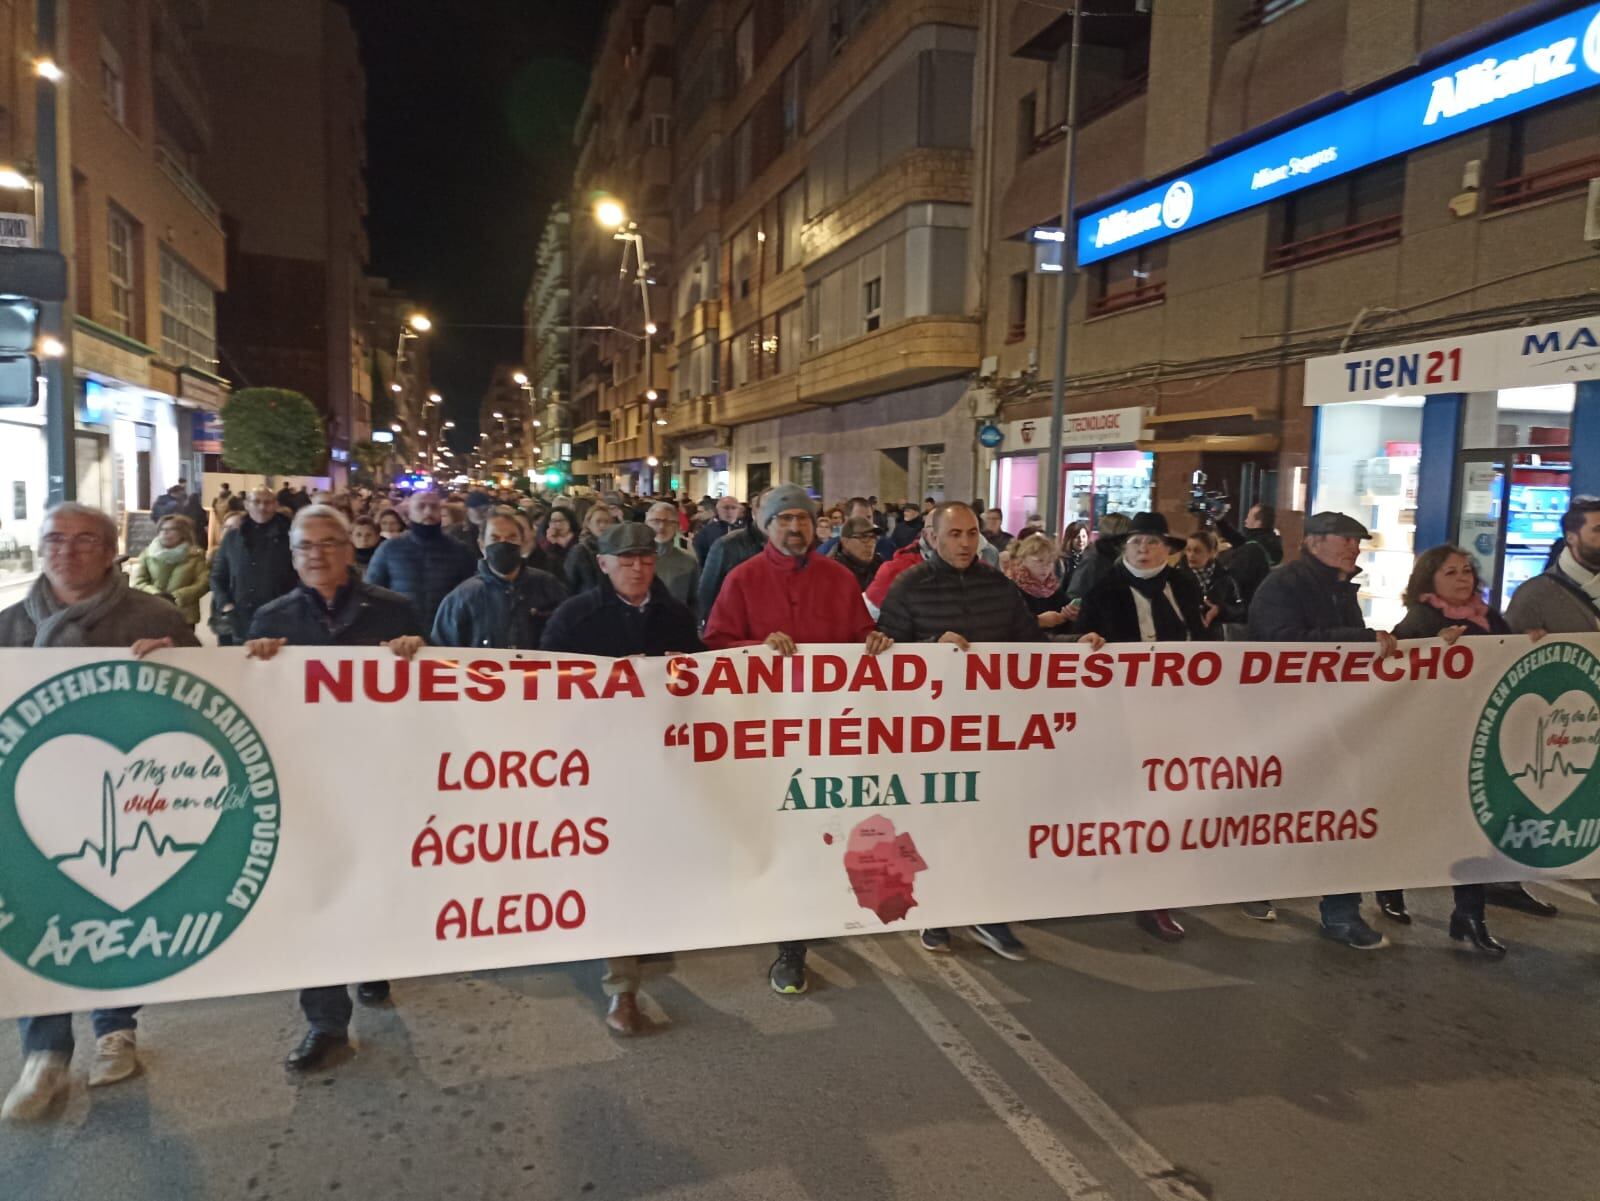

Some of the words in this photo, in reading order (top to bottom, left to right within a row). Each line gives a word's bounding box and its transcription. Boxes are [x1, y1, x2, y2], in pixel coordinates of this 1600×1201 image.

[1422, 37, 1577, 126] Allianz
[1288, 147, 1338, 176] Seguros
[1095, 202, 1162, 248] Allianz
[16, 664, 131, 727] DEFENSA
[136, 665, 173, 697] DE
[172, 677, 207, 710] LA
[304, 659, 646, 703] NUESTRA
[664, 653, 943, 700] SANIDAD,
[965, 652, 1222, 691] NUESTRO
[1239, 645, 1474, 683] DERECHO
[203, 698, 275, 799] SANIDAD
[664, 708, 1077, 763] “DEFIÉNDELA”
[1471, 709, 1499, 825] PLATAFORMA
[1492, 682, 1512, 708] EN
[1509, 645, 1561, 688] DEFENSA
[1562, 645, 1580, 665] DE
[1576, 652, 1593, 675] LA
[171, 761, 197, 778] va
[200, 754, 222, 778] la
[437, 748, 590, 791] LORCA
[777, 768, 911, 811] ÁREA
[920, 770, 981, 805] III
[1142, 755, 1282, 792] TOTANA
[123, 787, 169, 815] vida
[172, 796, 201, 809] en
[226, 803, 281, 910] PÚBLICA
[411, 814, 610, 867] ÁGUILAS
[1029, 819, 1170, 858] PUERTO
[1181, 807, 1378, 850] LUMBRERAS
[435, 889, 586, 941] ALEDO
